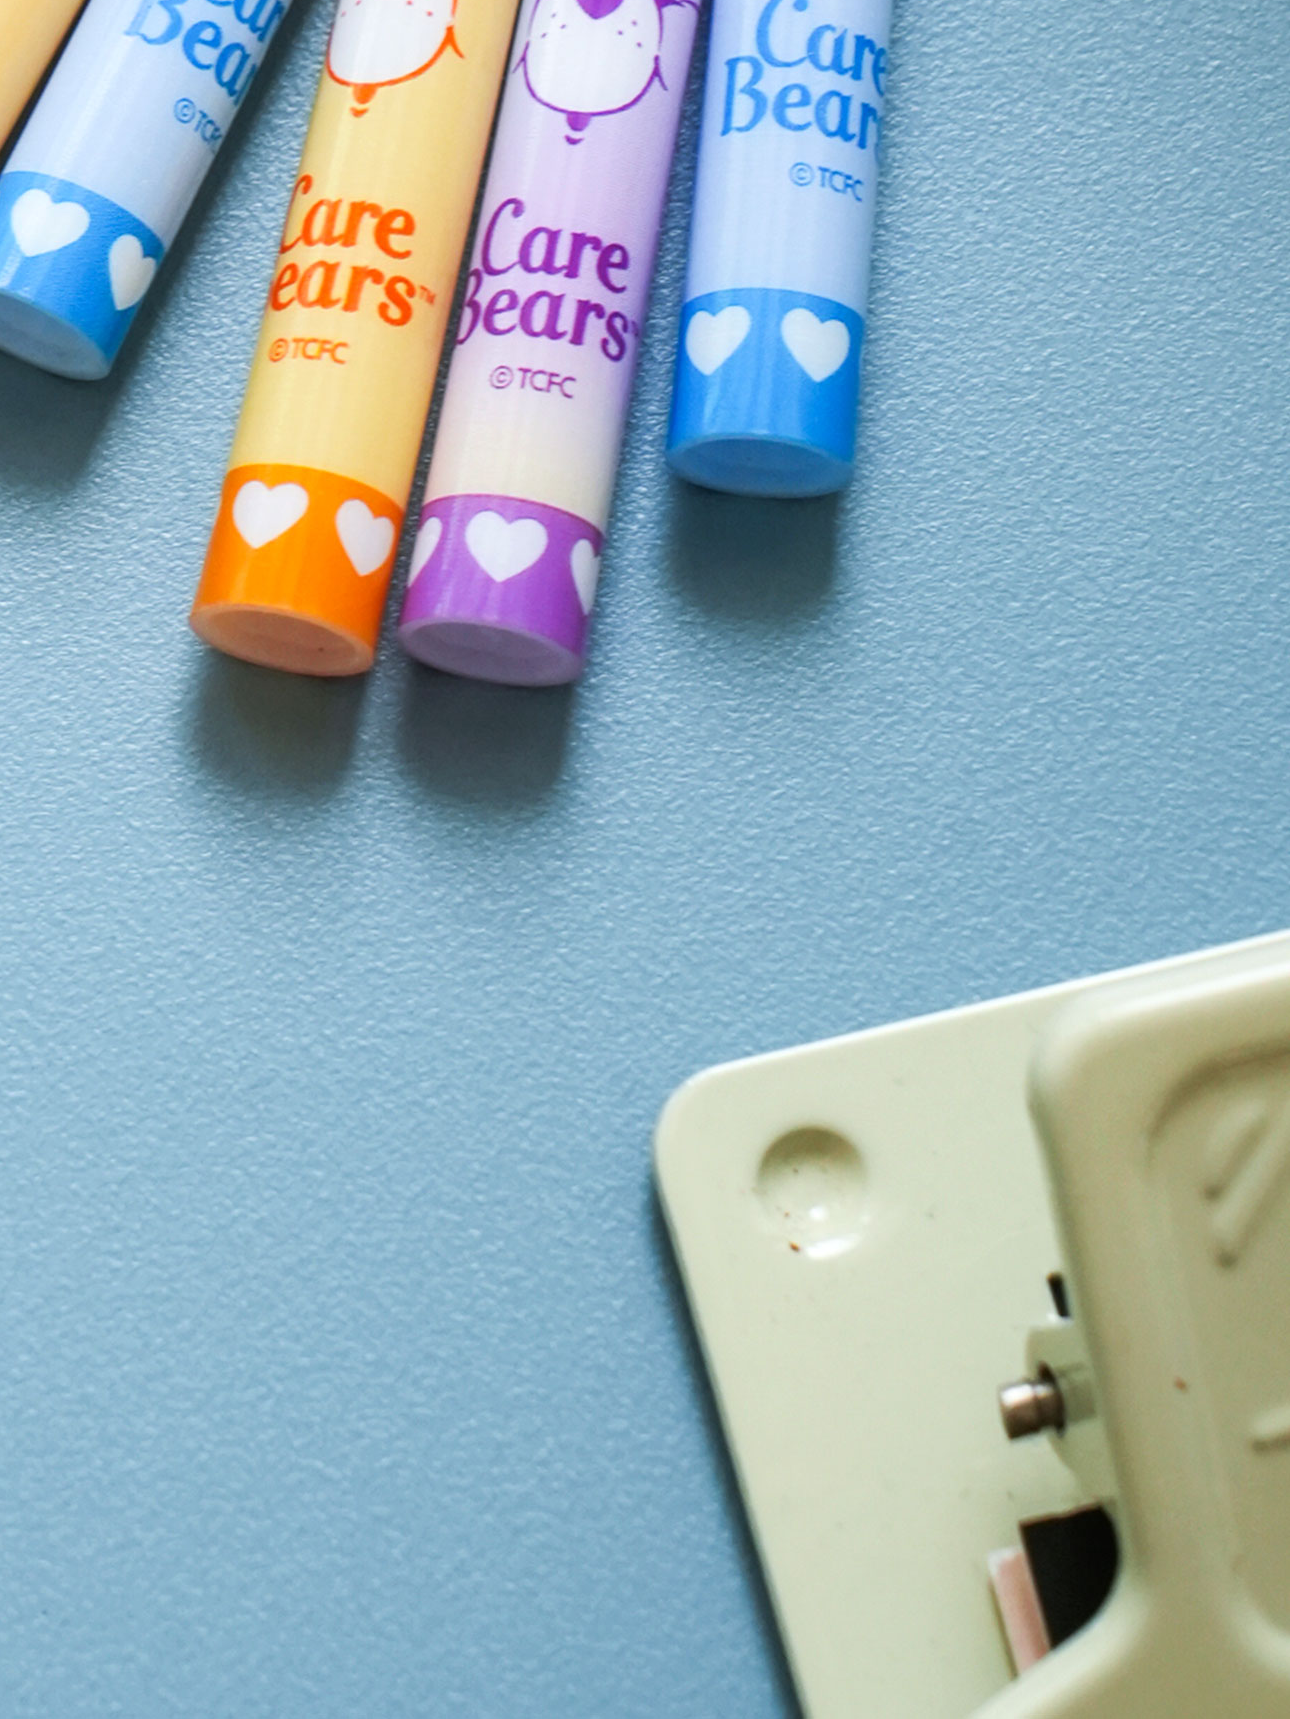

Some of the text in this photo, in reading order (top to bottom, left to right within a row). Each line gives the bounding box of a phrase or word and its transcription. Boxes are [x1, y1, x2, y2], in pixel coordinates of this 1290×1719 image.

[720, 55, 880, 150] Bear
[269, 259, 437, 327] ears™
[481, 197, 630, 294] Care
